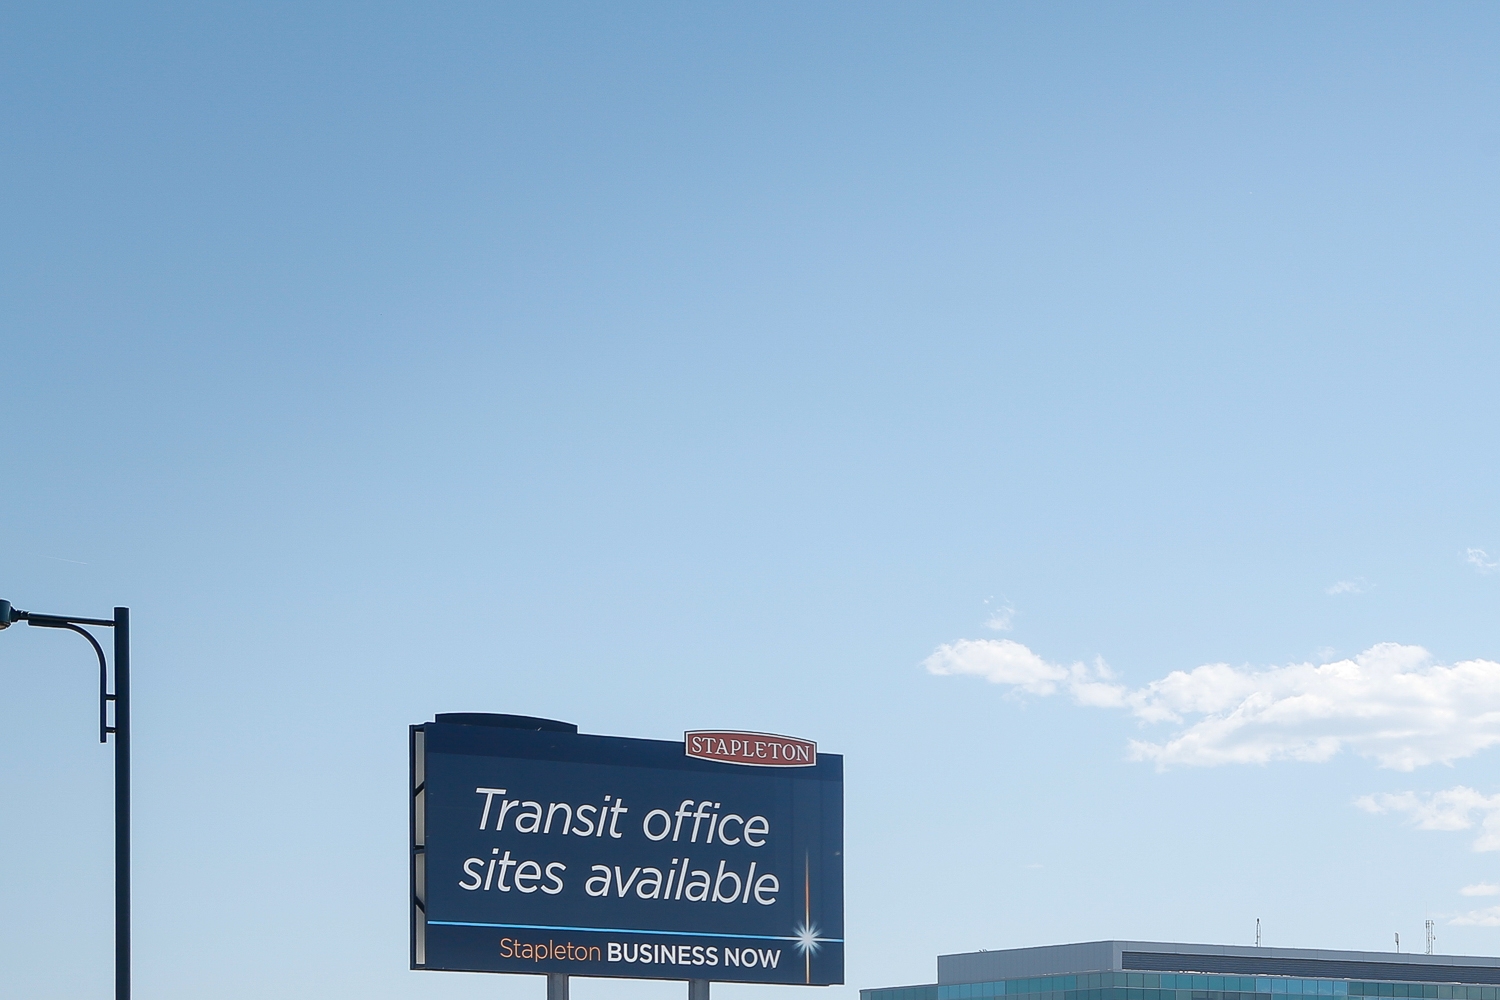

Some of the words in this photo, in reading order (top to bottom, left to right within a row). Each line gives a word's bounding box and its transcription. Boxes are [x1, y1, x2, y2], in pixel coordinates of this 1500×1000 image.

[691, 735, 811, 762] STAPLETON
[475, 787, 628, 839] Transit
[642, 800, 770, 848] office
[458, 848, 567, 895] sites
[584, 858, 780, 906] available
[499, 937, 601, 963] Stapleton
[607, 942, 719, 967] BUSINESS
[724, 948, 781, 970] NOW
